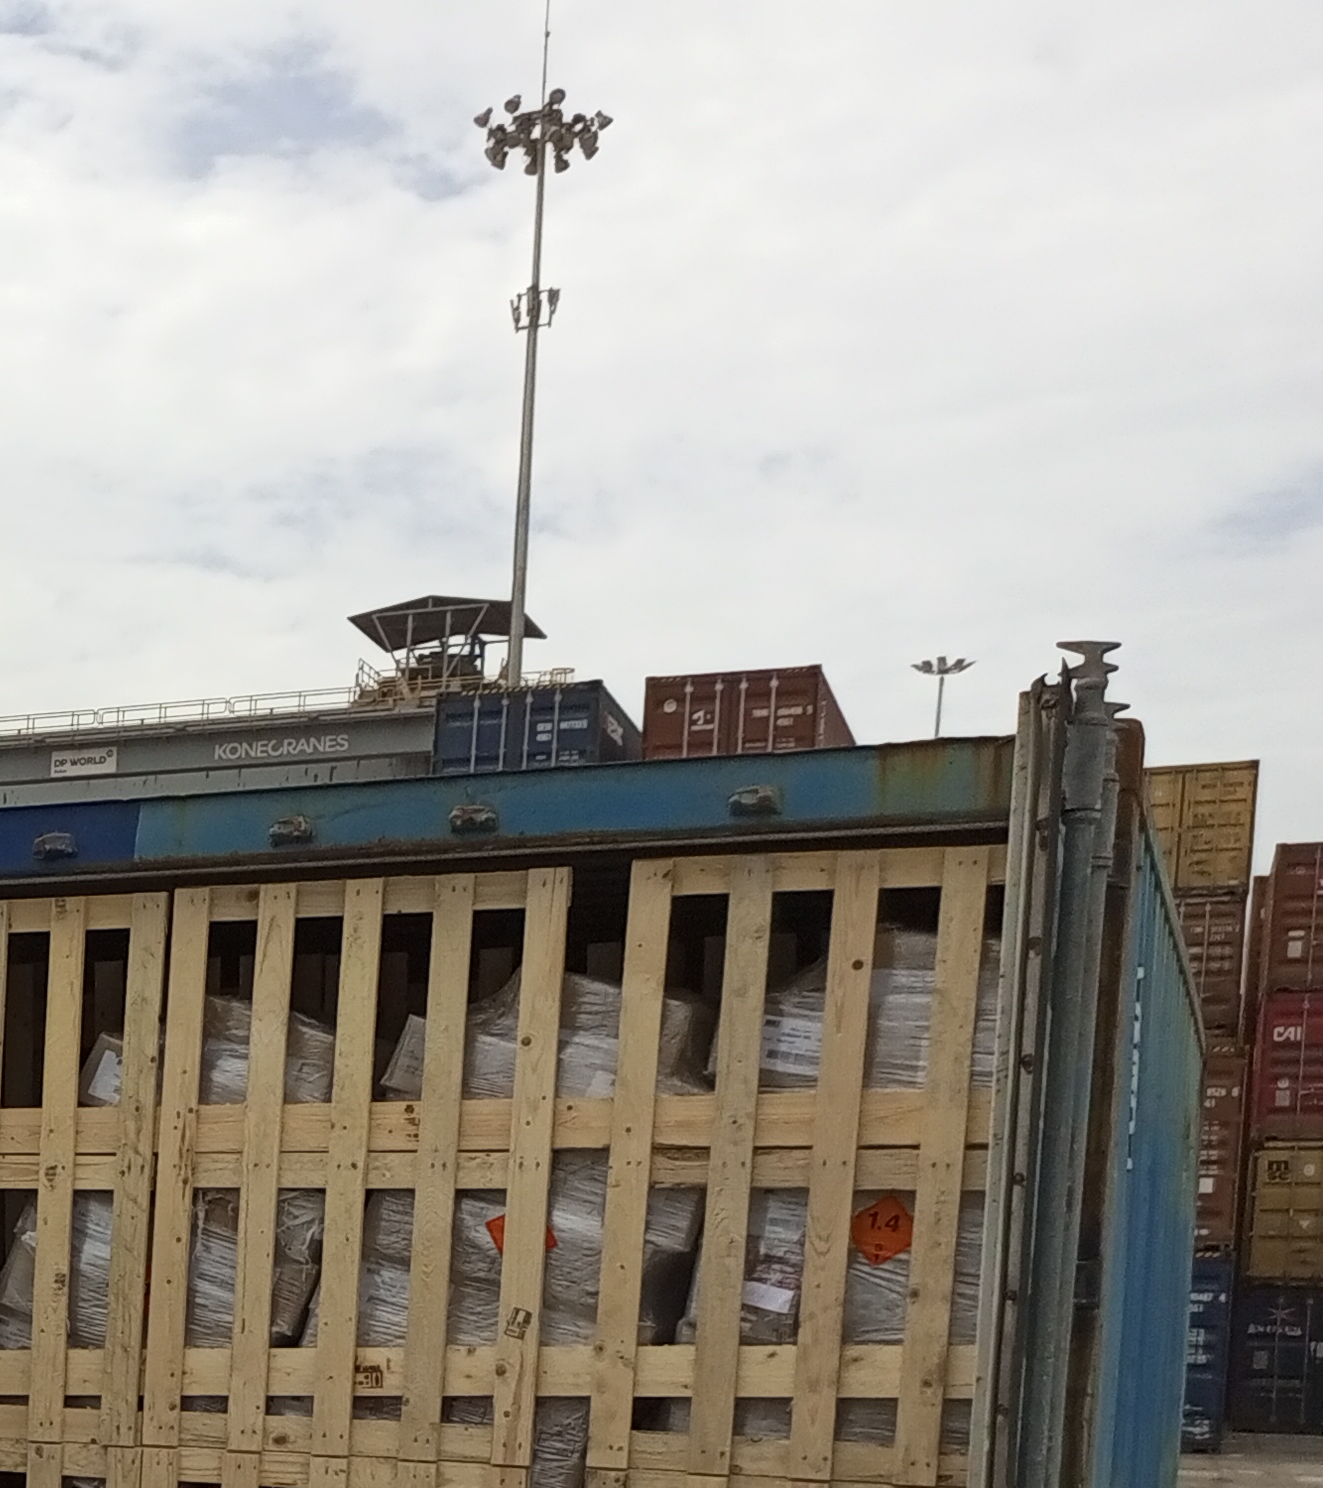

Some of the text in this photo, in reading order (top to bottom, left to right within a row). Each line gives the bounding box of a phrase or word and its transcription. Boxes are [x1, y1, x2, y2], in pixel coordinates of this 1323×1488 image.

[214, 734, 349, 760] KONECRANES
[54, 755, 107, 768] DP WORLD
[1273, 1026, 1302, 1042] CAI
[868, 1210, 900, 1233] 1.4
